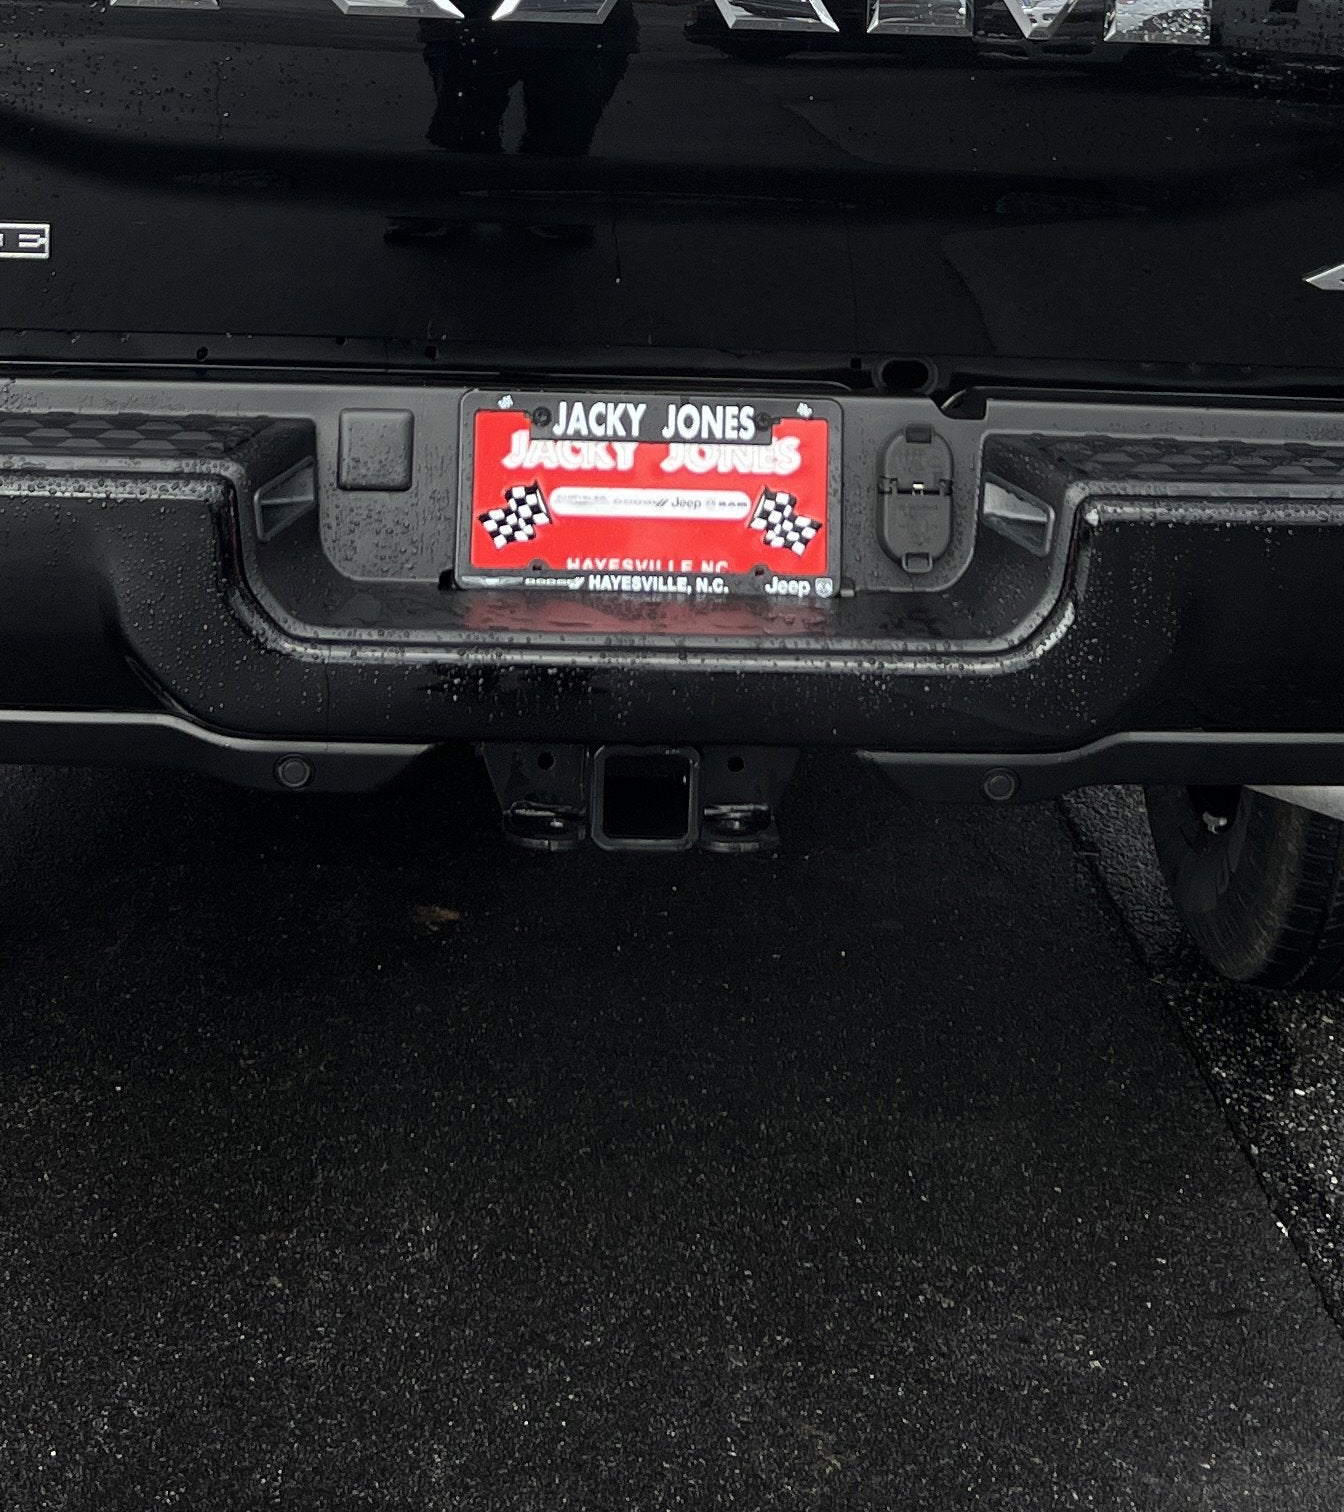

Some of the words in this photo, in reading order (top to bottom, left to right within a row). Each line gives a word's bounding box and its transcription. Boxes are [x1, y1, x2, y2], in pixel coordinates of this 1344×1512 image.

[552, 401, 646, 437] JACKY
[662, 403, 755, 440] JONES
[501, 429, 639, 471] JACKY
[659, 435, 802, 476] JONES
[671, 497, 702, 510] Jeep
[588, 574, 692, 594] HAYESVILLE,
[695, 576, 729, 594] N.C.
[764, 576, 811, 598] Jeep
